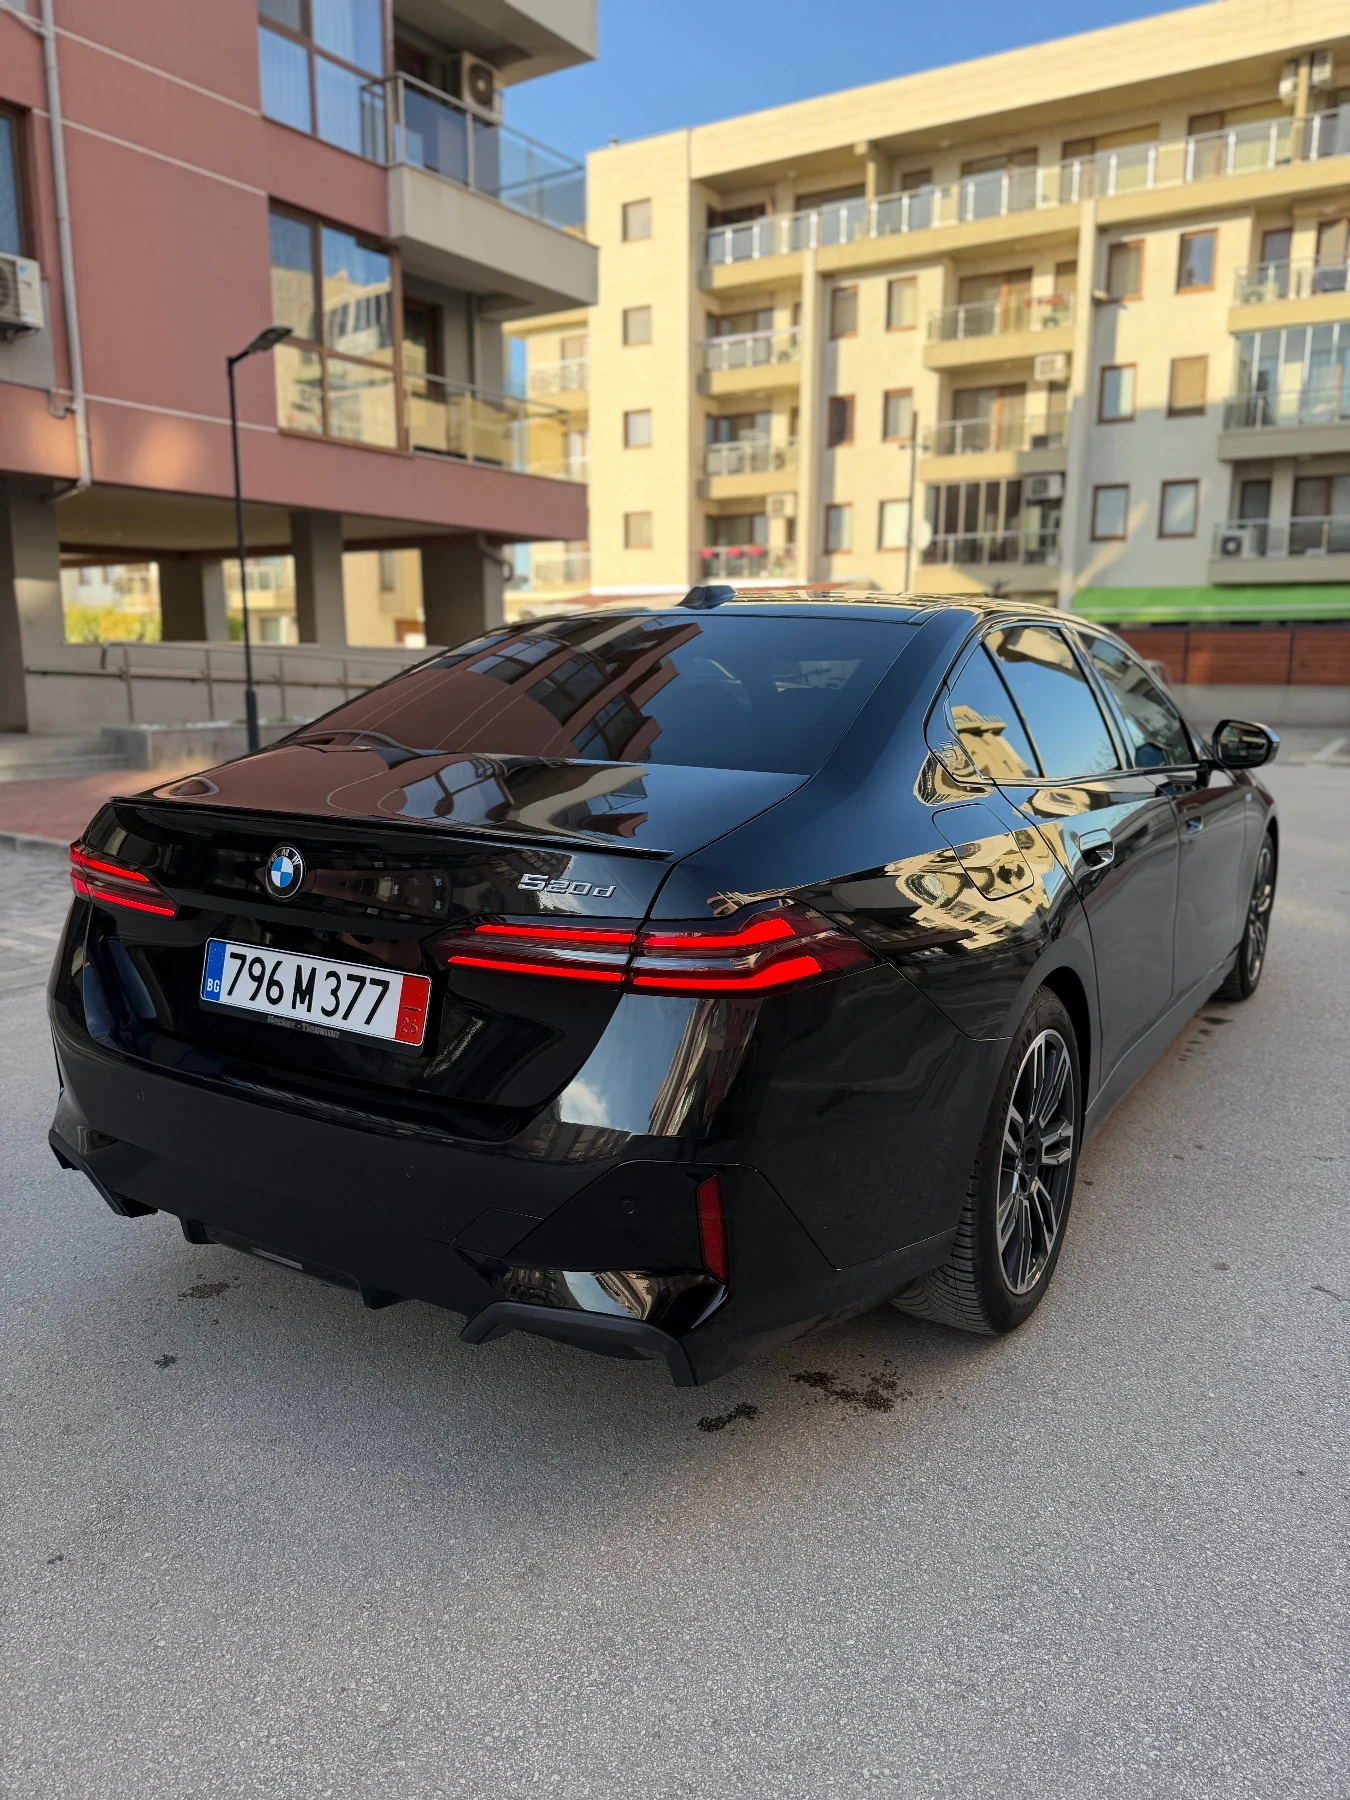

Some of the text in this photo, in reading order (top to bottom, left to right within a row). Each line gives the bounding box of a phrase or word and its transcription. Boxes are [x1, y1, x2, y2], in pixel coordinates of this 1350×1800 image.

[270, 848, 301, 866] BMW
[517, 873, 616, 898] 520d
[206, 978, 221, 993] BG
[400, 1016, 419, 1035] 26
